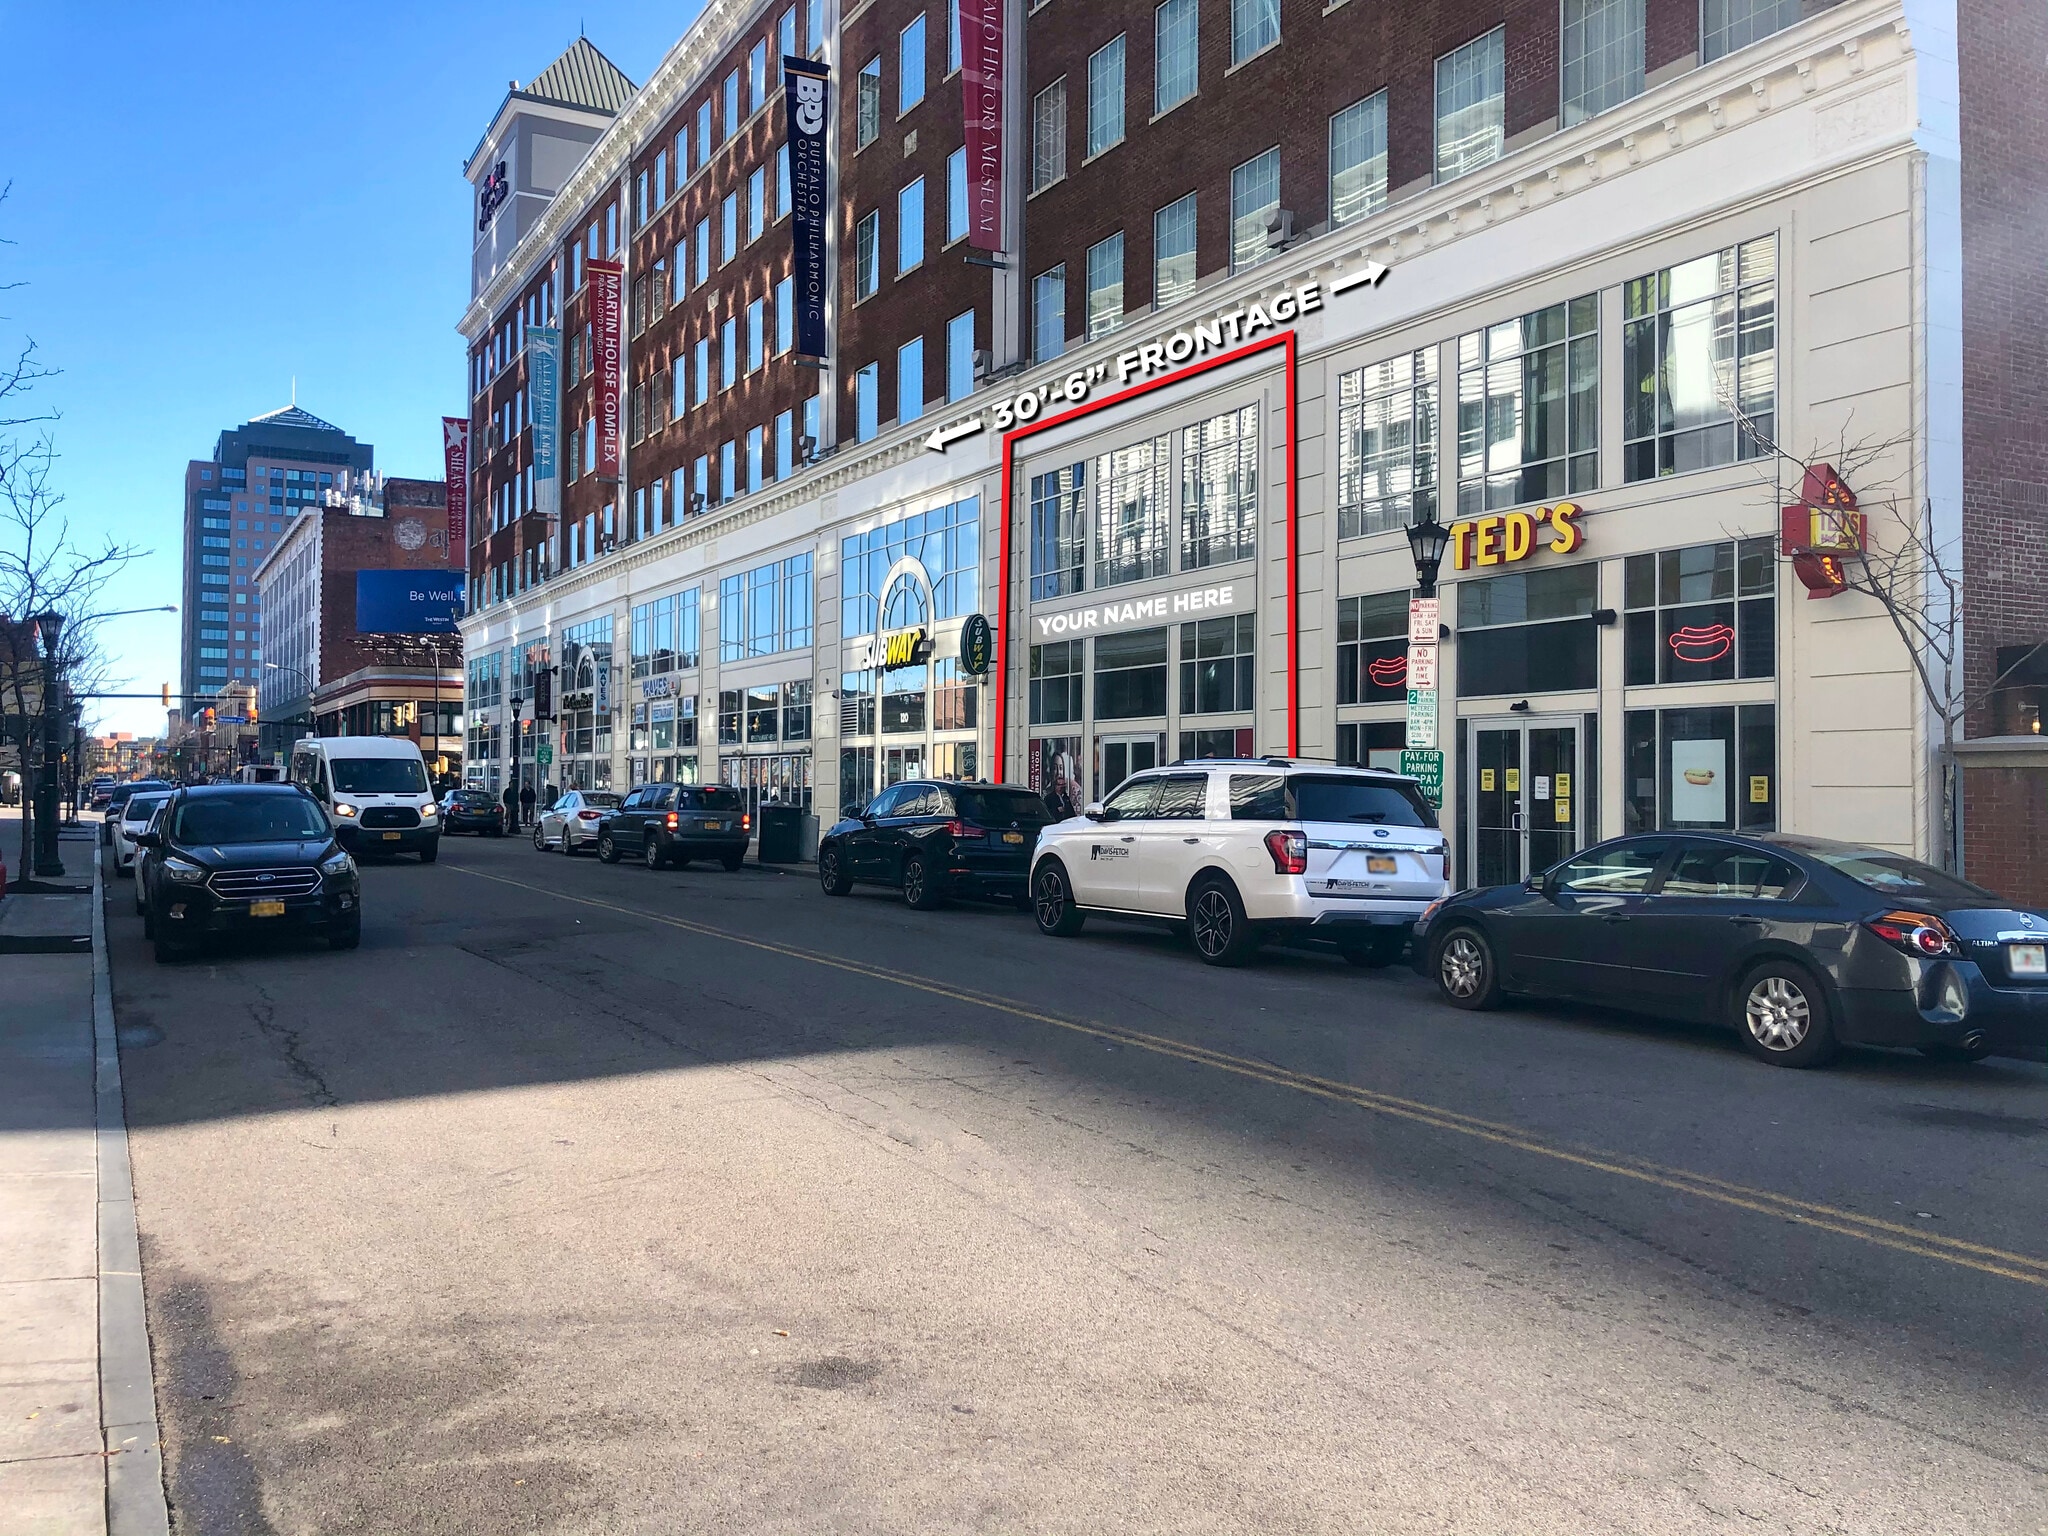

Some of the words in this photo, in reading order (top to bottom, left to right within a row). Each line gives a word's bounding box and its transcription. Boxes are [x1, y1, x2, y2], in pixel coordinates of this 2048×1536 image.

[982, 47, 998, 136] HISTORY
[797, 138, 807, 222] ORCHESTRA
[810, 139, 820, 205] BUFFALO
[980, 143, 998, 233] MUSEUM
[808, 209, 820, 321] PHILHARMONIC
[606, 275, 619, 333] MARTIN
[605, 337, 617, 388] HOUSE
[604, 392, 617, 463] COMPLEX
[450, 450, 465, 489] SHEA'S
[540, 434, 551, 466] KNOX
[1450, 502, 1582, 570] TED'S
[409, 590, 425, 601] Be
[428, 590, 456, 602] Well,
[1411, 602, 1419, 611] NO
[863, 630, 921, 670] SUBWAY
[973, 619, 984, 669] SUBWAY
[1416, 649, 1428, 658] NO
[599, 667, 608, 700] WAVES
[1409, 691, 1417, 703] 2
[1405, 751, 1420, 761] PAY
[1423, 751, 1440, 762] FOR
[1406, 762, 1438, 773] PARKING
[1420, 774, 1439, 785] PAY
